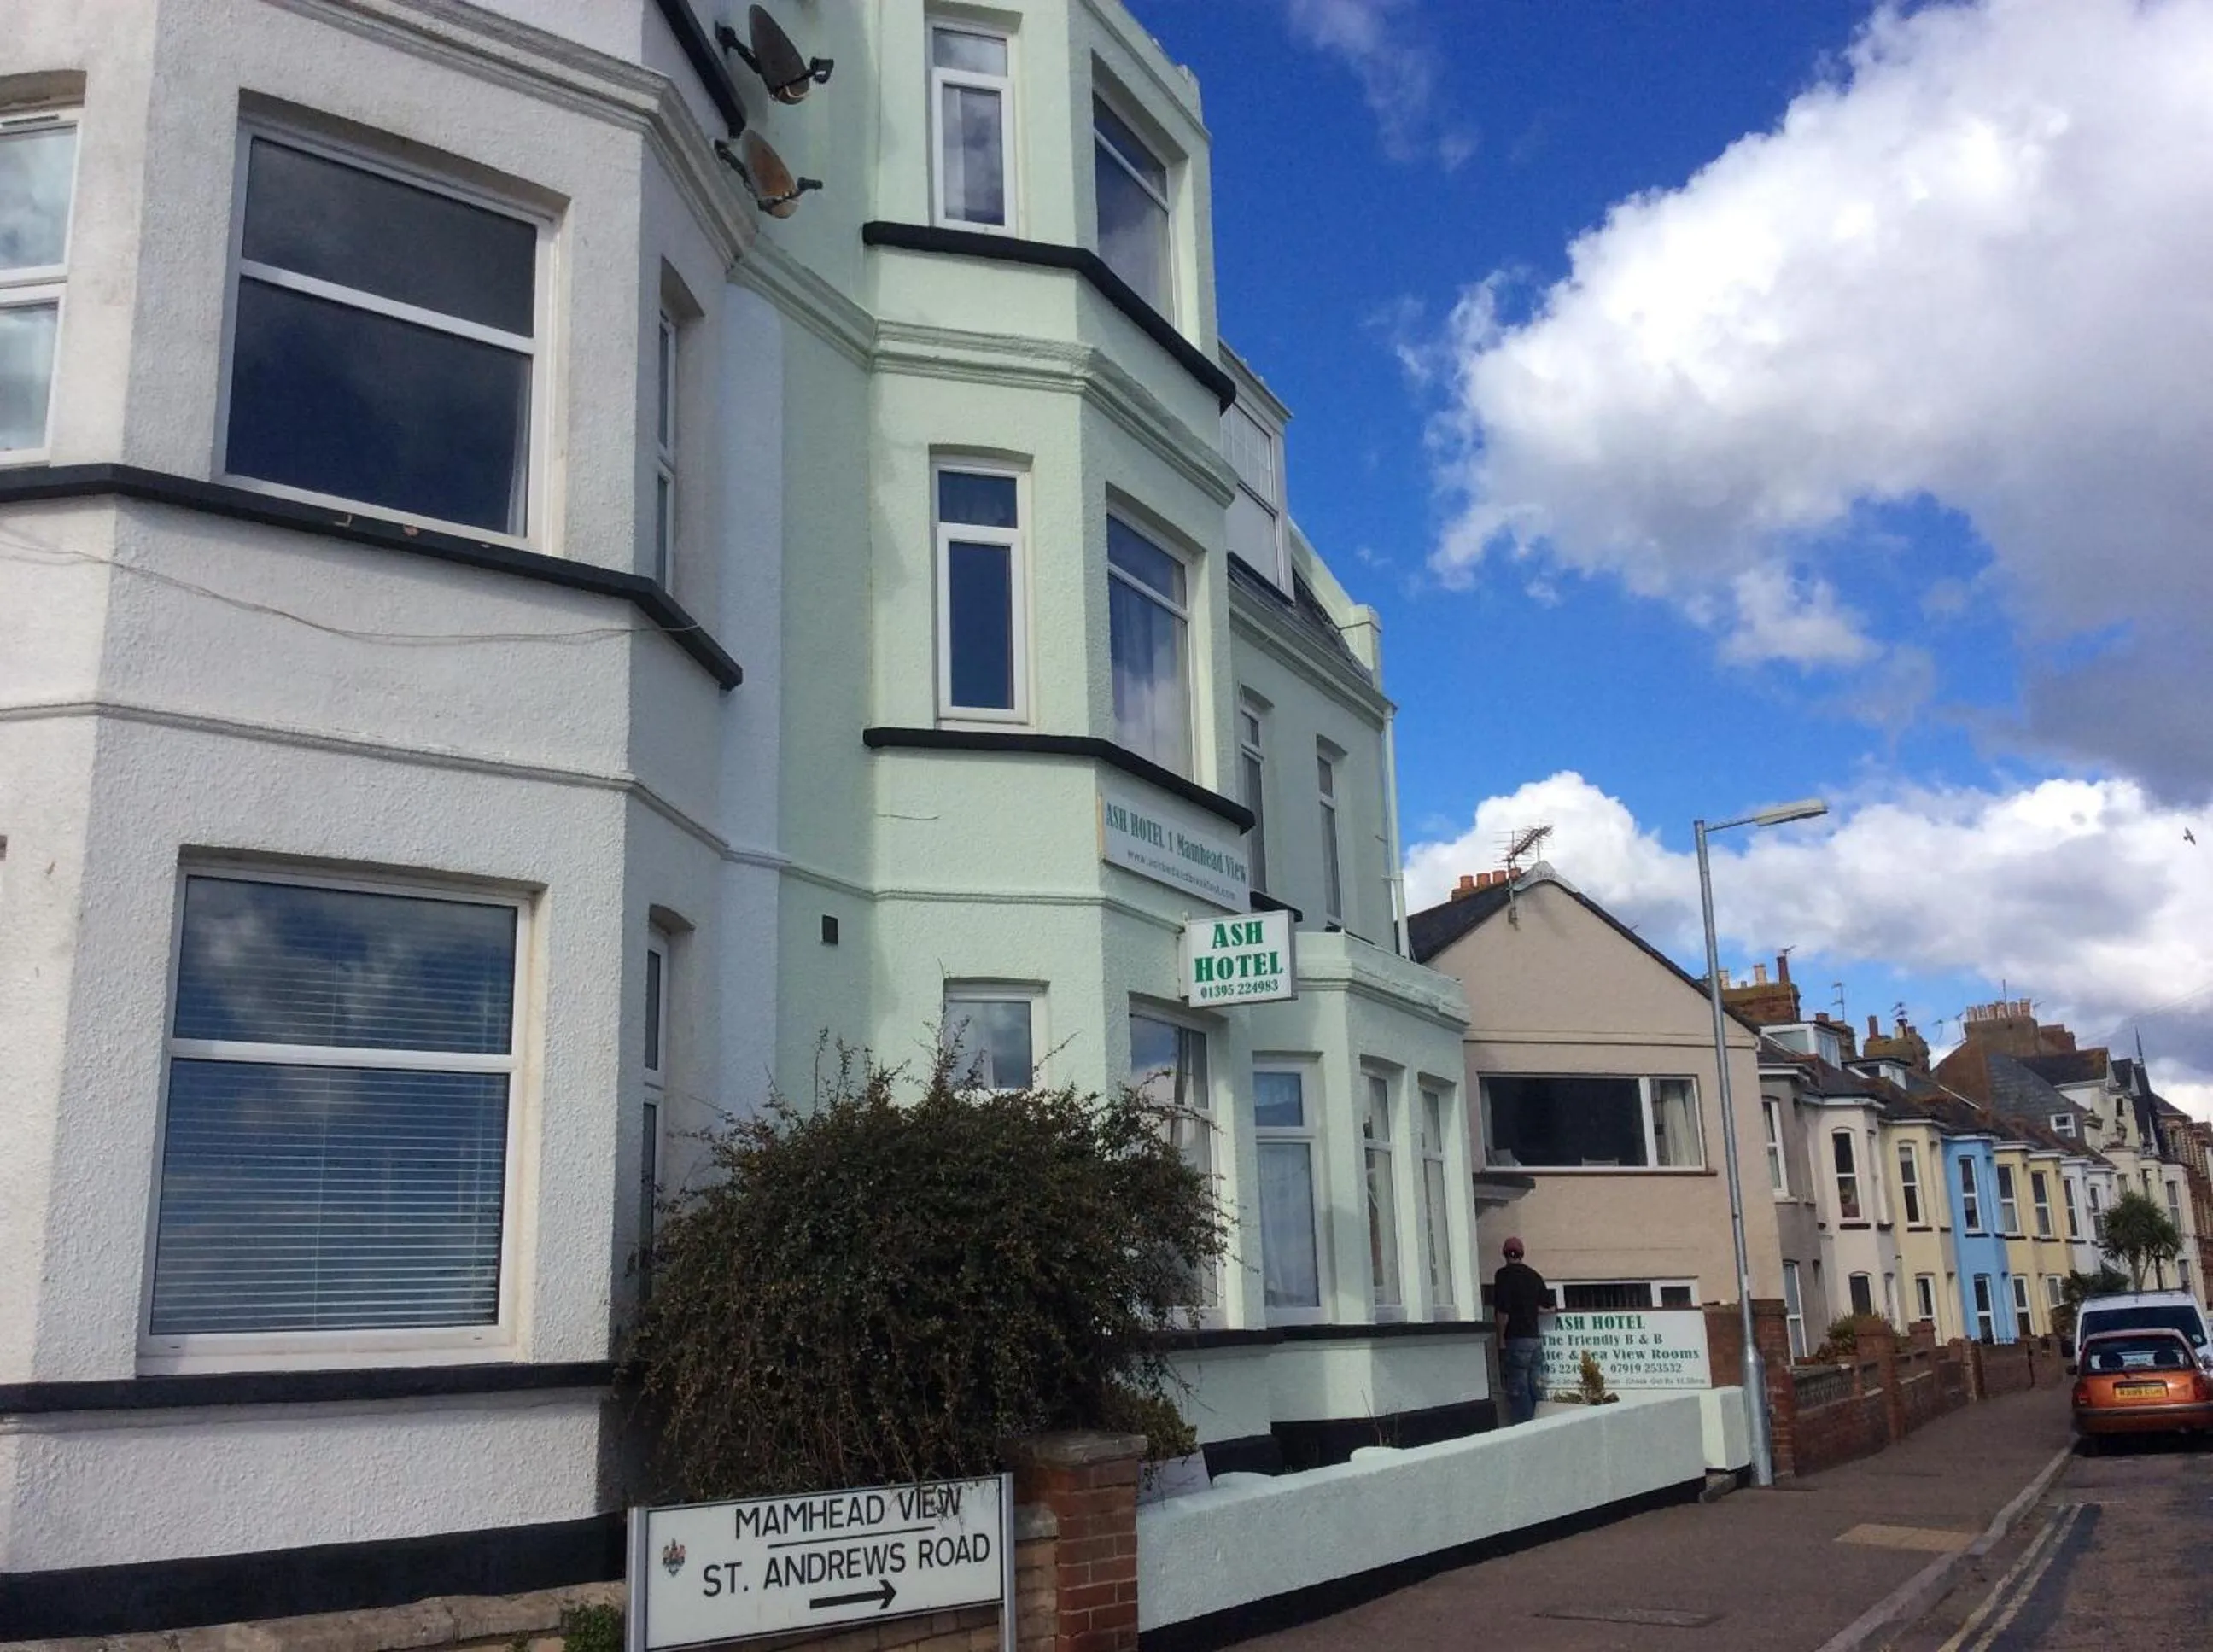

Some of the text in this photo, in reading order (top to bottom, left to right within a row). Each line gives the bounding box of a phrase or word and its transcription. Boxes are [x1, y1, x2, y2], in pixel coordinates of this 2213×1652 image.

[1106, 802, 1247, 884] ASH HOTEL 1 Mamhead View
[1212, 920, 1263, 949] ASH
[1194, 951, 1282, 983] HOTEL
[1200, 979, 1278, 999] 01395 224983
[1554, 1315, 1645, 1331] ASH HOTEL
[1542, 1334, 1663, 1347] The Friendly B & B
[1568, 1350, 1579, 1361] &
[1613, 1349, 1645, 1359] View
[1651, 1348, 1700, 1359] Rooms
[735, 1484, 962, 1539] MAMHEAD VIEW
[703, 1533, 991, 1597] ST. ANDREWS ROAD
